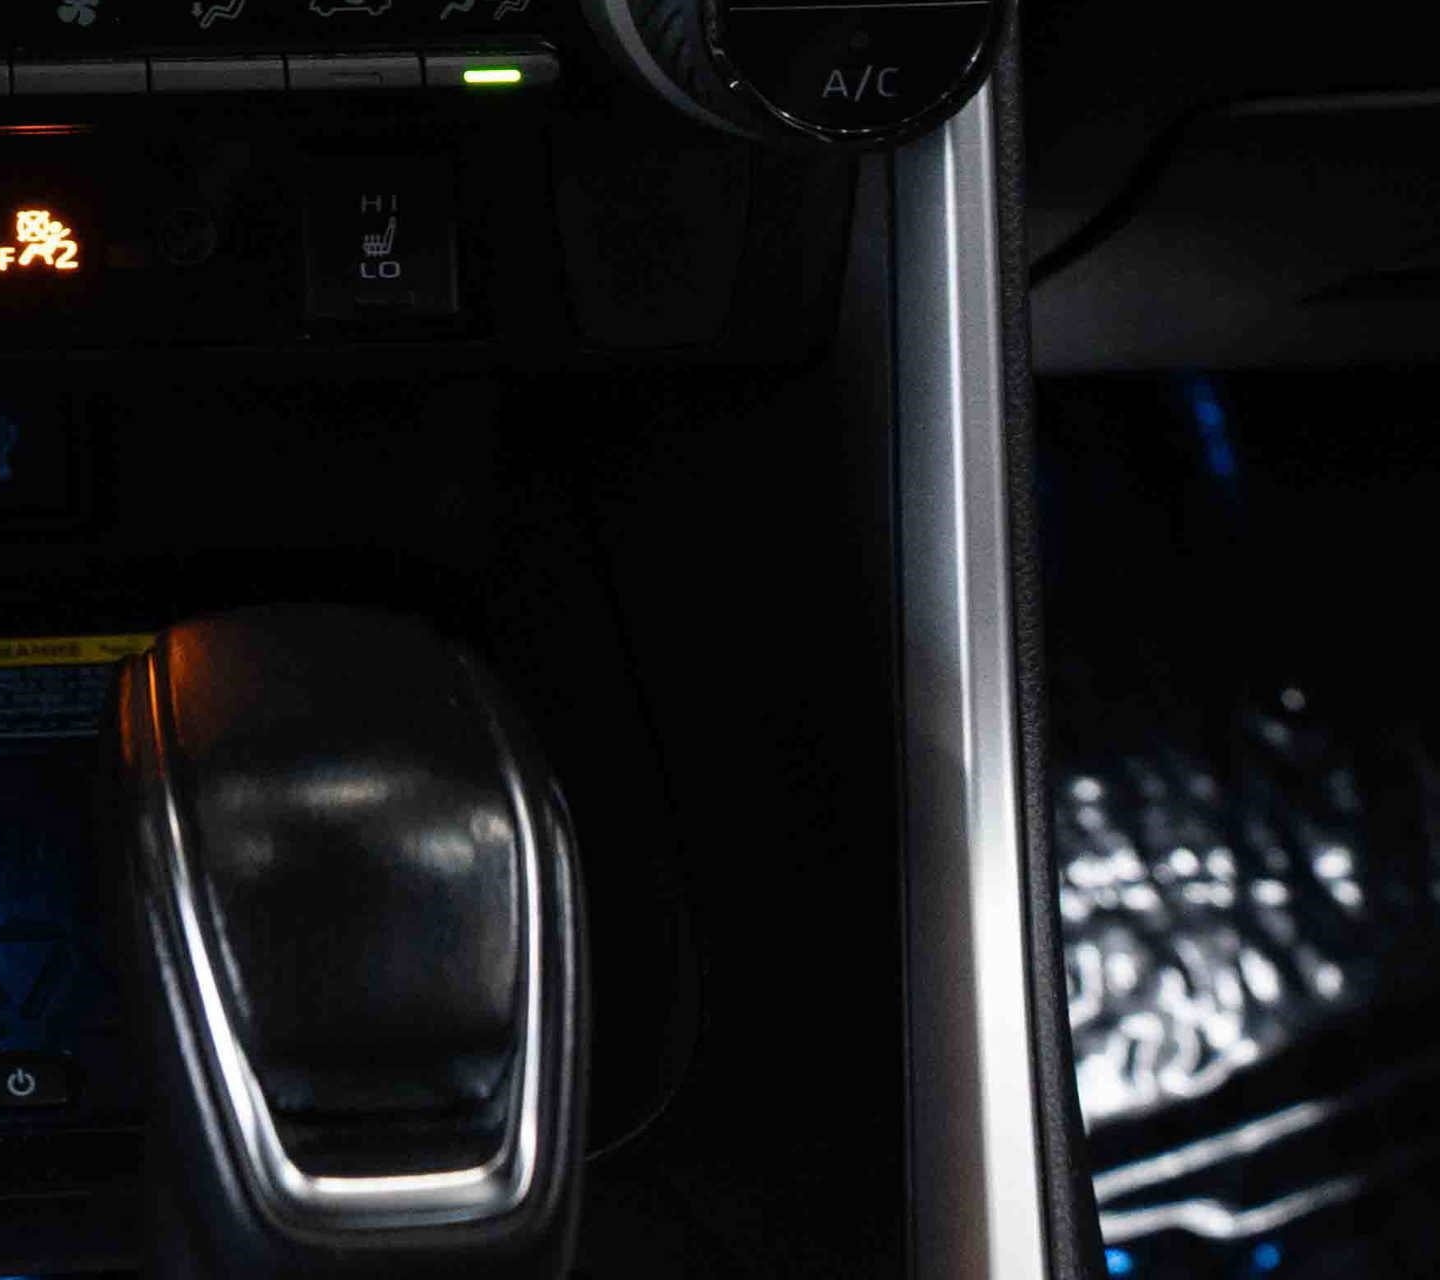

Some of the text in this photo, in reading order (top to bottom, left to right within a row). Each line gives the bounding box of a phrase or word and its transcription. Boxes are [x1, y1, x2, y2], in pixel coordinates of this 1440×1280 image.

[822, 65, 898, 102] A/C
[360, 194, 398, 213] HI
[360, 261, 401, 279] LO
